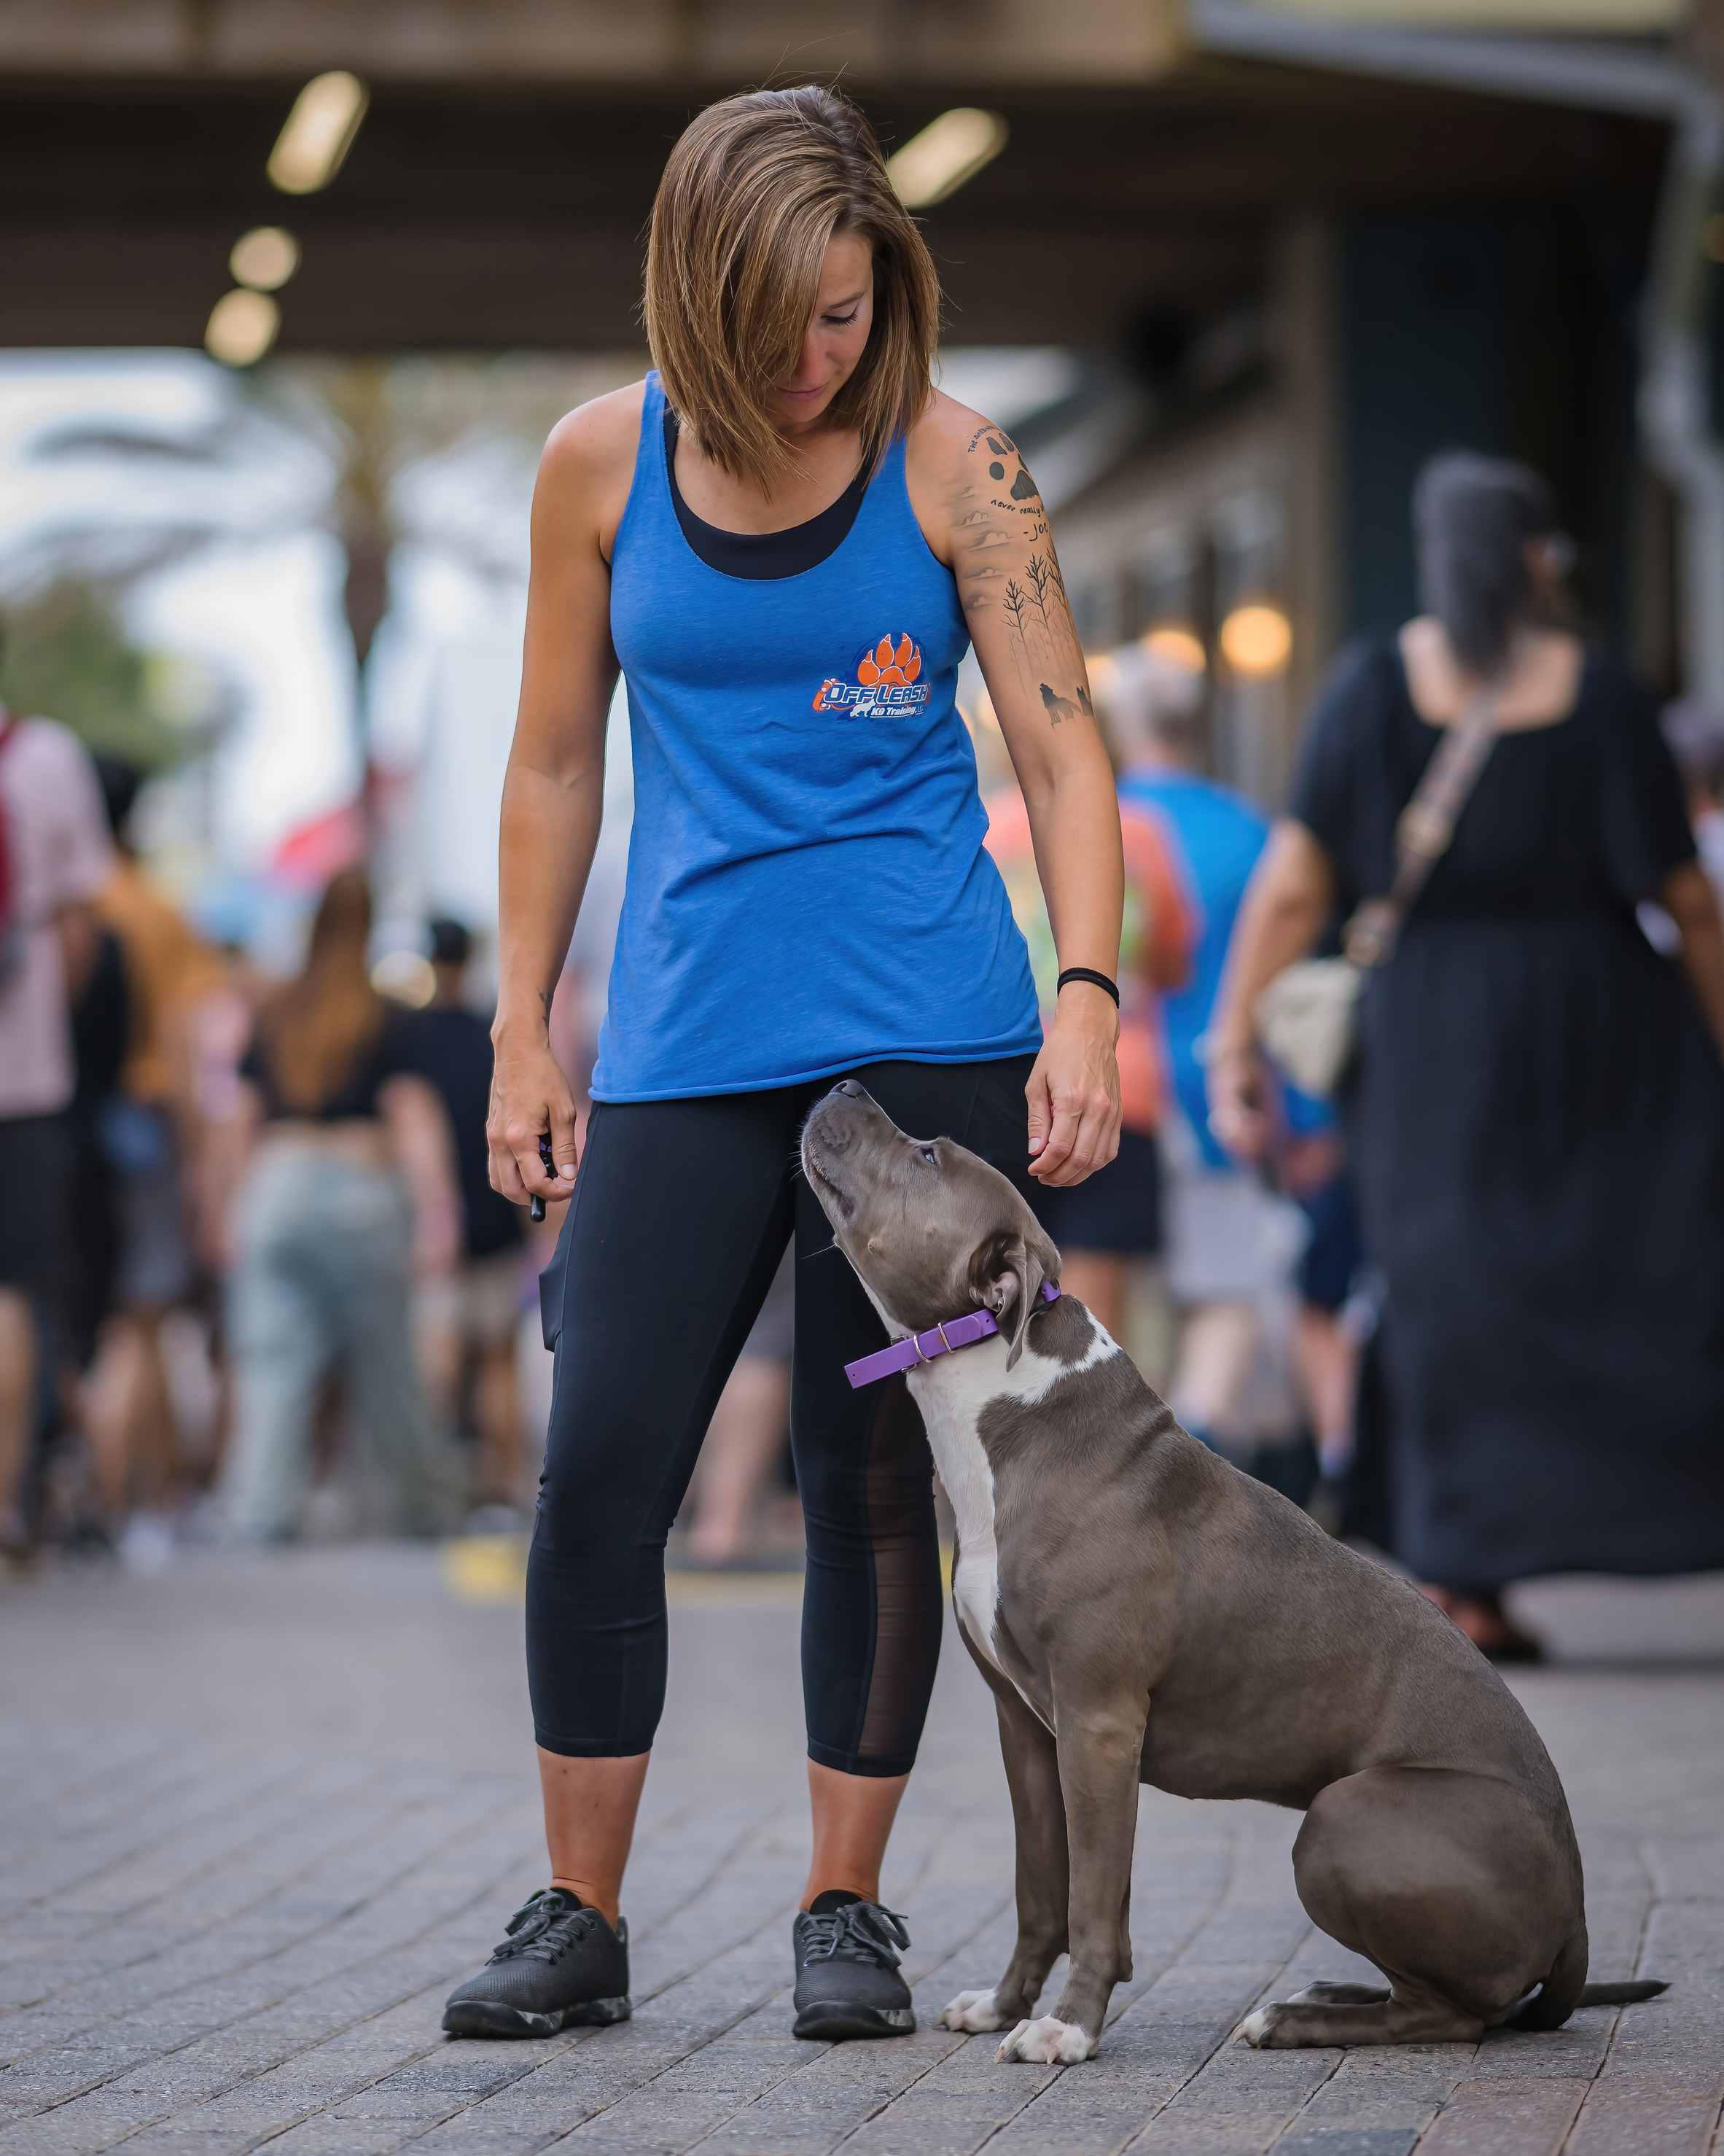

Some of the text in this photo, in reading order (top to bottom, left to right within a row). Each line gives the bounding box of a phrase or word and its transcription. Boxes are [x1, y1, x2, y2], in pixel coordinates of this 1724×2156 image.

[991, 499, 1015, 512] never
[1020, 506, 1041, 518] really
[870, 707, 885, 716] K9
